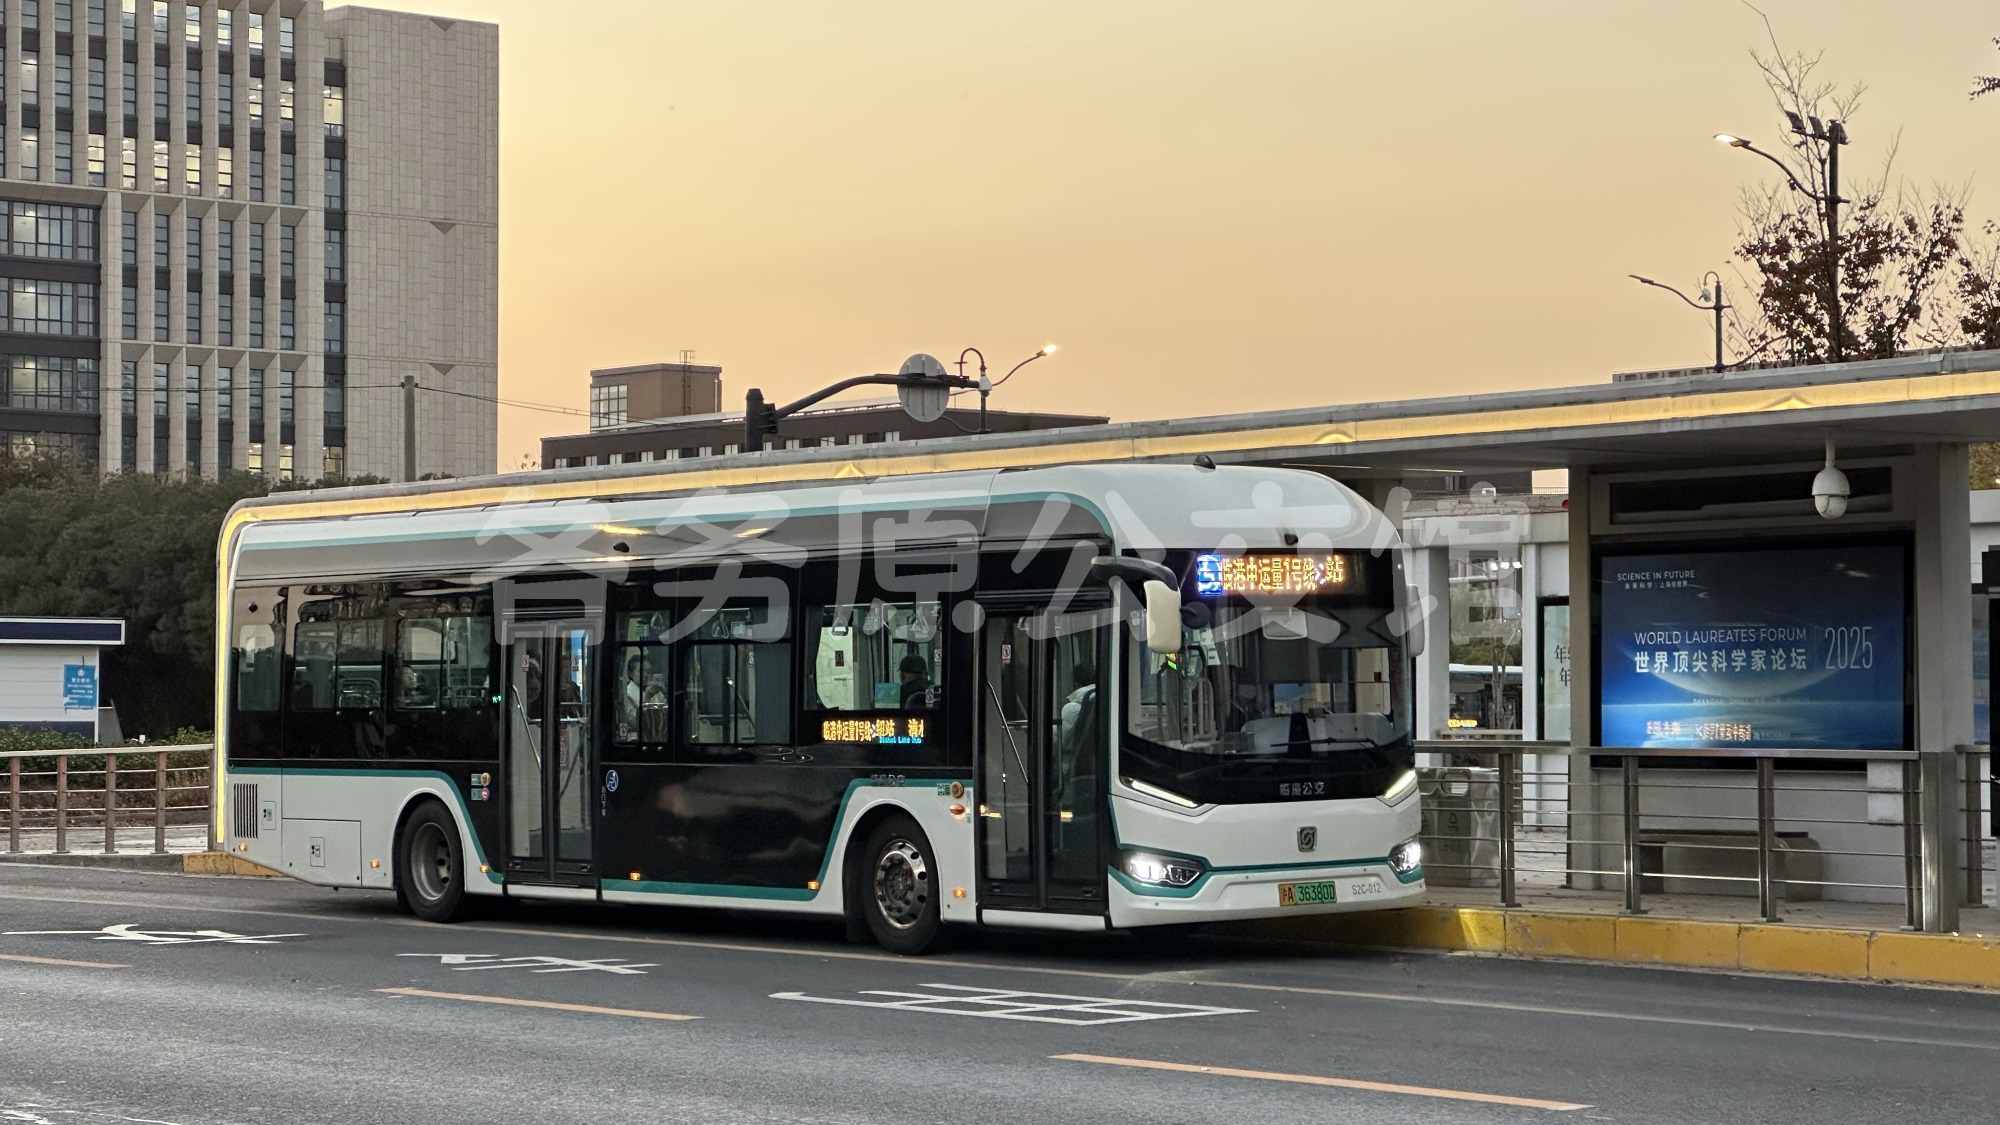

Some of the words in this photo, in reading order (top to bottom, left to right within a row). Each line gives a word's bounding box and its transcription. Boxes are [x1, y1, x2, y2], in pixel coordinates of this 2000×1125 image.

[1617, 572, 1651, 581] SCIENCE
[1653, 571, 1662, 580] IN
[1664, 570, 1695, 579] FUTURE
[1634, 630, 1681, 646] WORLD
[1685, 629, 1756, 644] LAUREATES
[1760, 627, 1807, 642] FORUM
[1554, 645, 1571, 663] 年
[1824, 626, 1874, 670] 2025
[1634, 647, 1807, 674] 世界顶尖科学家论坛
[1352, 883, 1381, 895] S2C-012
